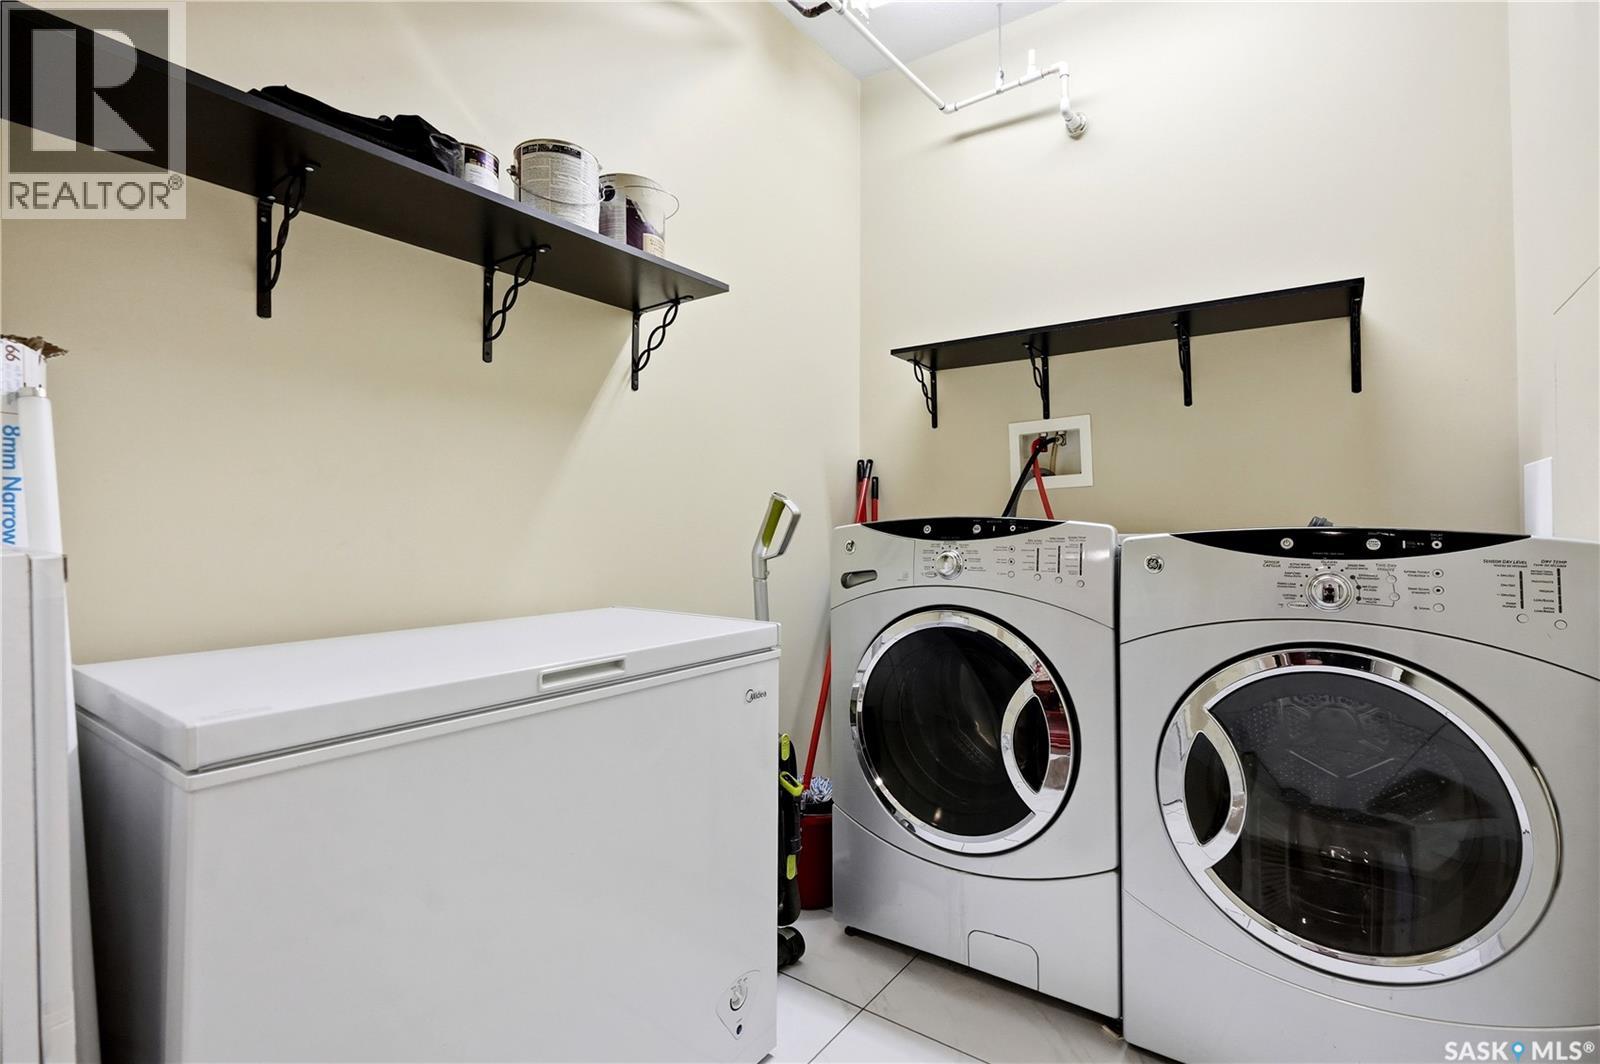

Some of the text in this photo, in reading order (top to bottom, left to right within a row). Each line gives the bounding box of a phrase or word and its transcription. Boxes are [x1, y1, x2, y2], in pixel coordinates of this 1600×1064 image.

[2, 425, 22, 545] 8mm Narrow
[746, 688, 767, 703] Midea
